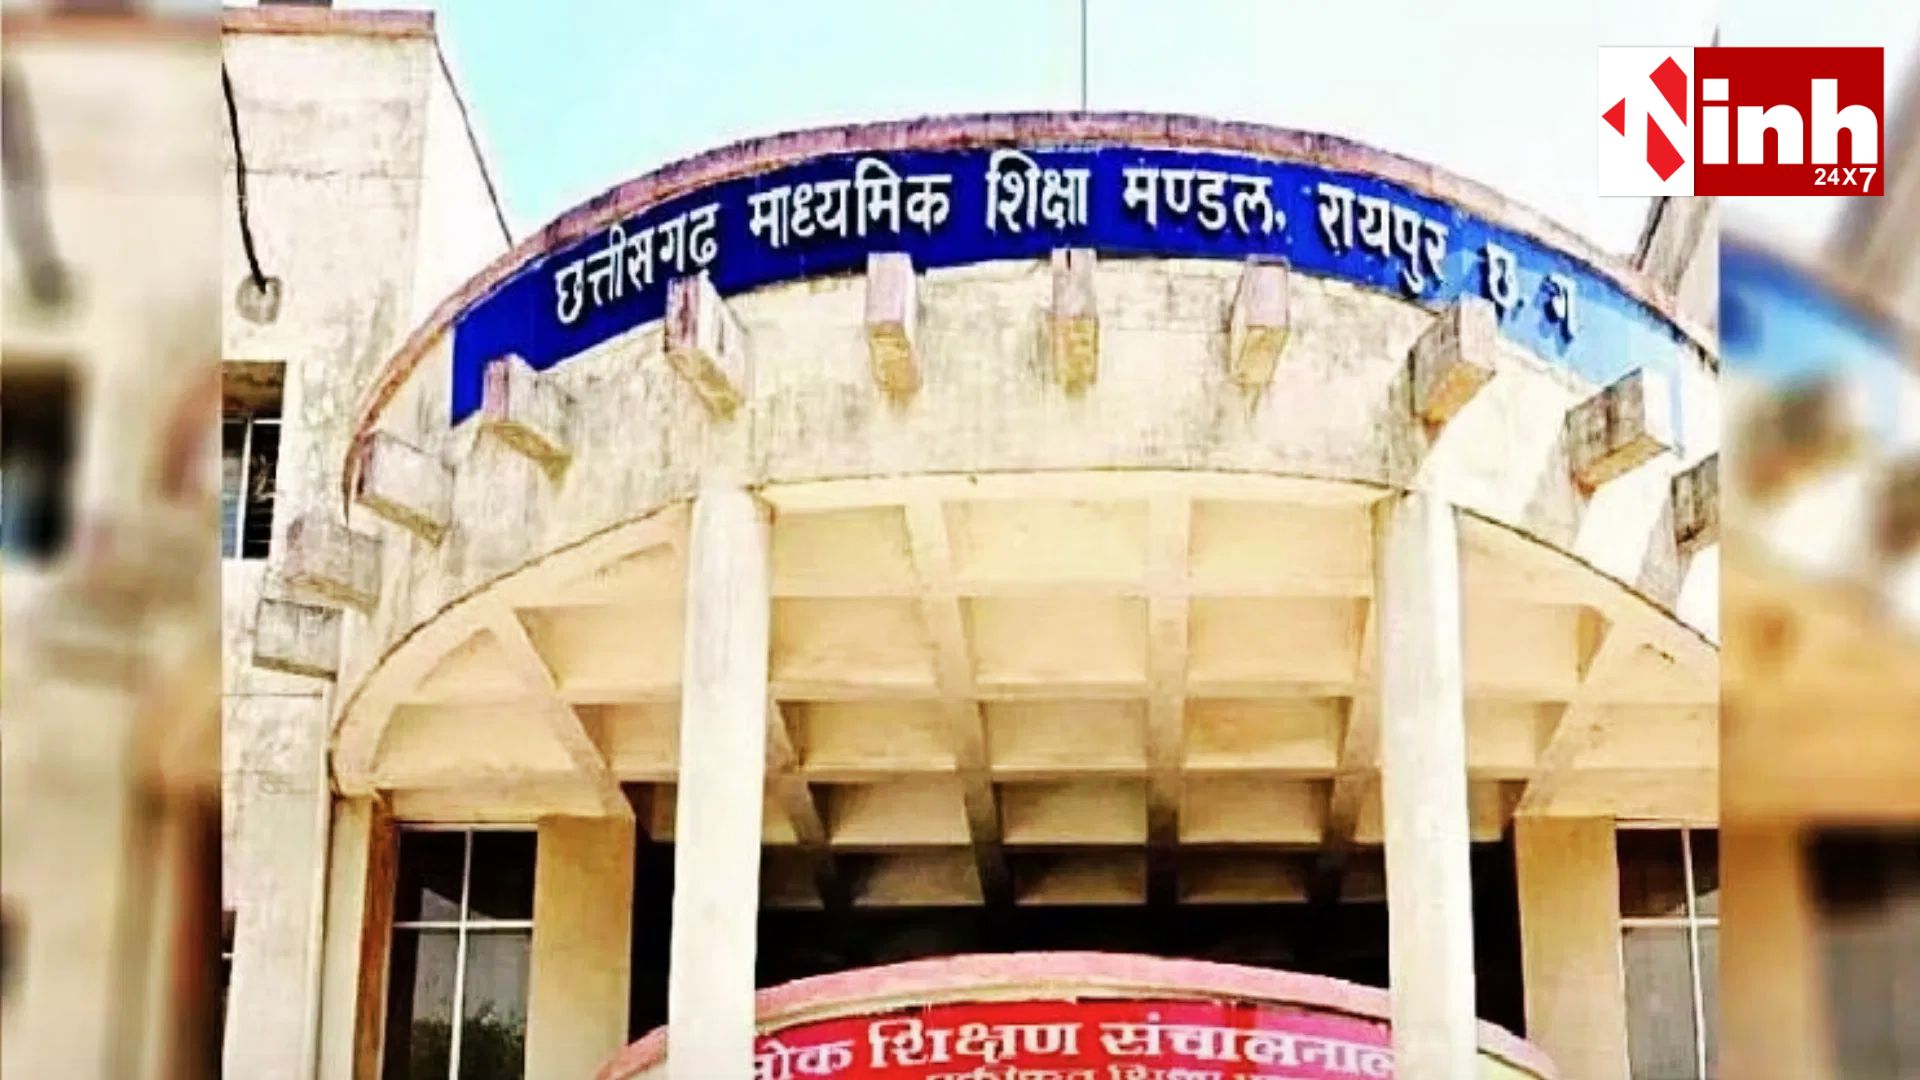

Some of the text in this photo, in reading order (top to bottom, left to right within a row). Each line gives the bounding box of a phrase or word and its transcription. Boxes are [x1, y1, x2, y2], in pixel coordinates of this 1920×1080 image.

[748, 157, 953, 247] माध्यमिक
[985, 150, 1091, 233] शिक्षा
[1317, 183, 1450, 294] रायपुर
[867, 1017, 1083, 1068] शिक्षण
